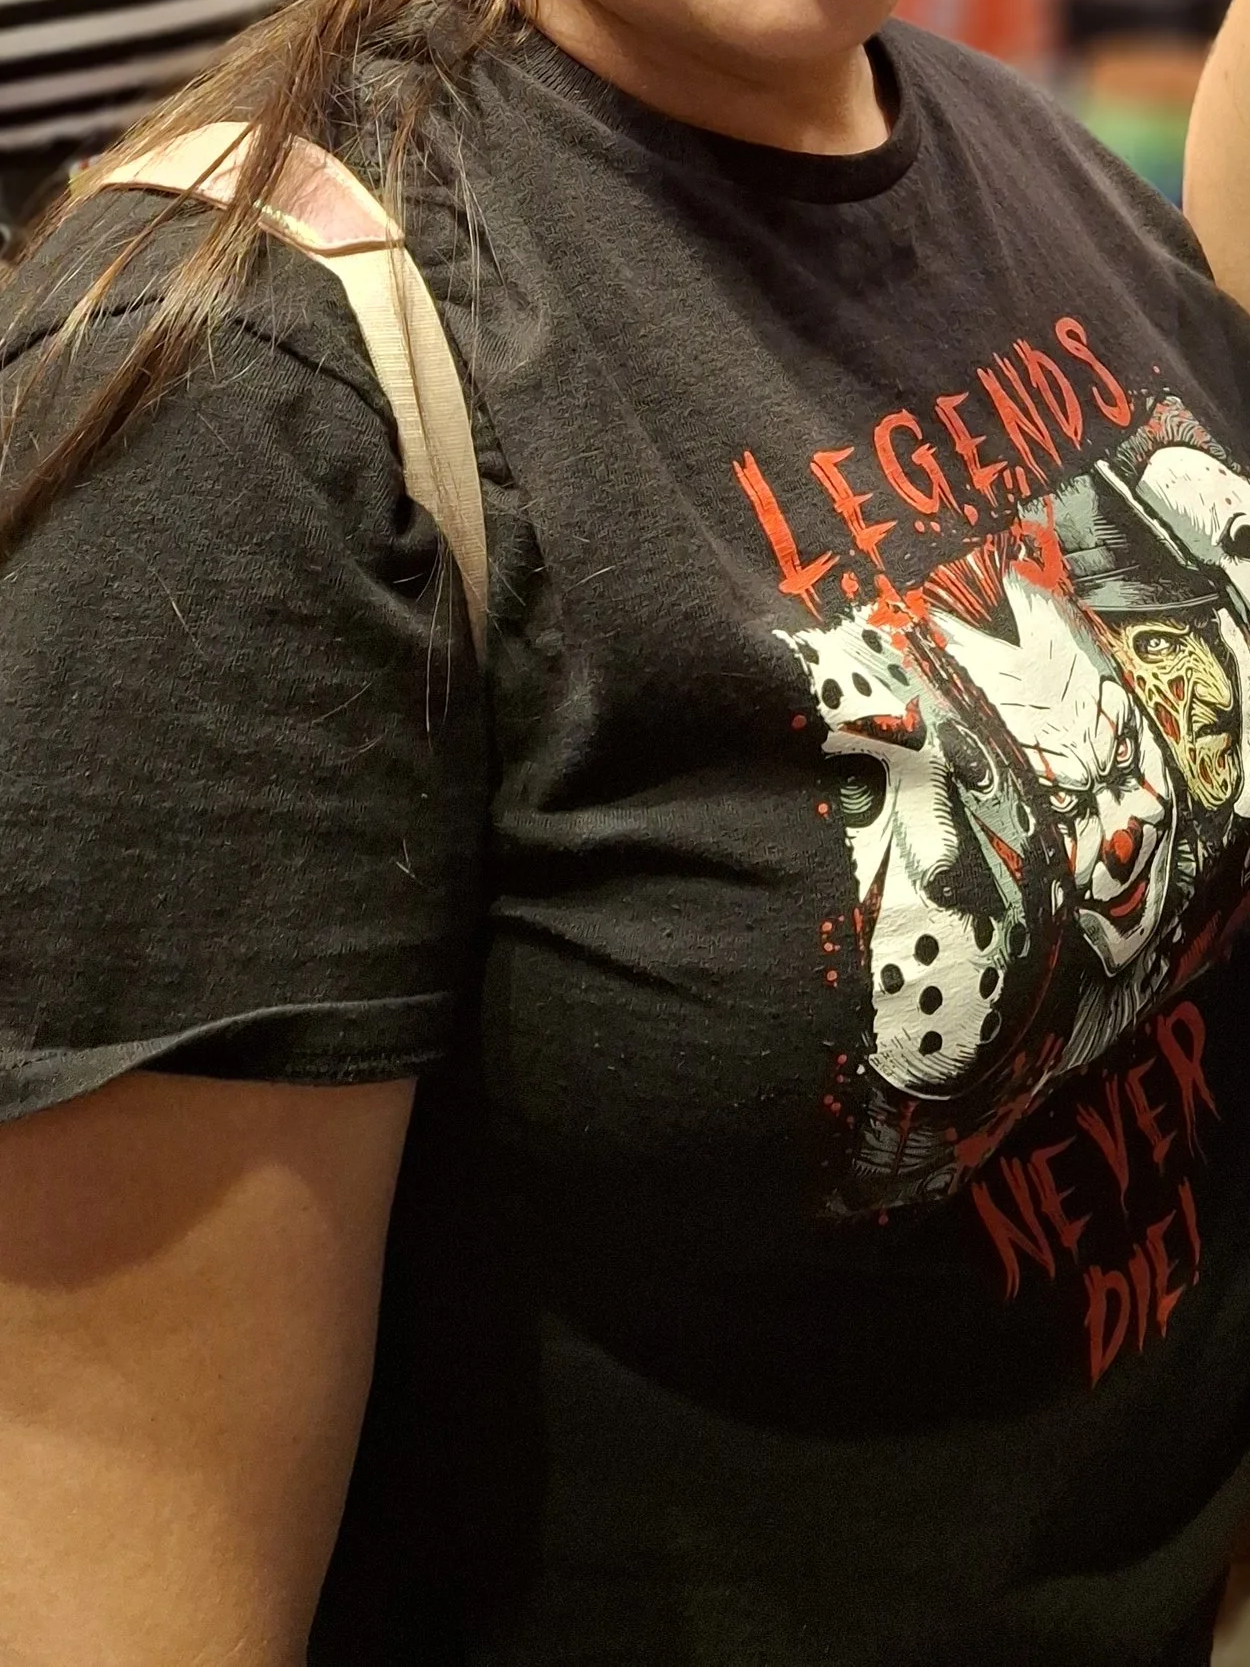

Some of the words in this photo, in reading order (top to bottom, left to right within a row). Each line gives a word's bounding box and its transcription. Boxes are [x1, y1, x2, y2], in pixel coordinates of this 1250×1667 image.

[733, 317, 1135, 623] LEGENDS
[971, 1001, 1221, 1301] NEVER
[1084, 1176, 1200, 1389] DIE!
